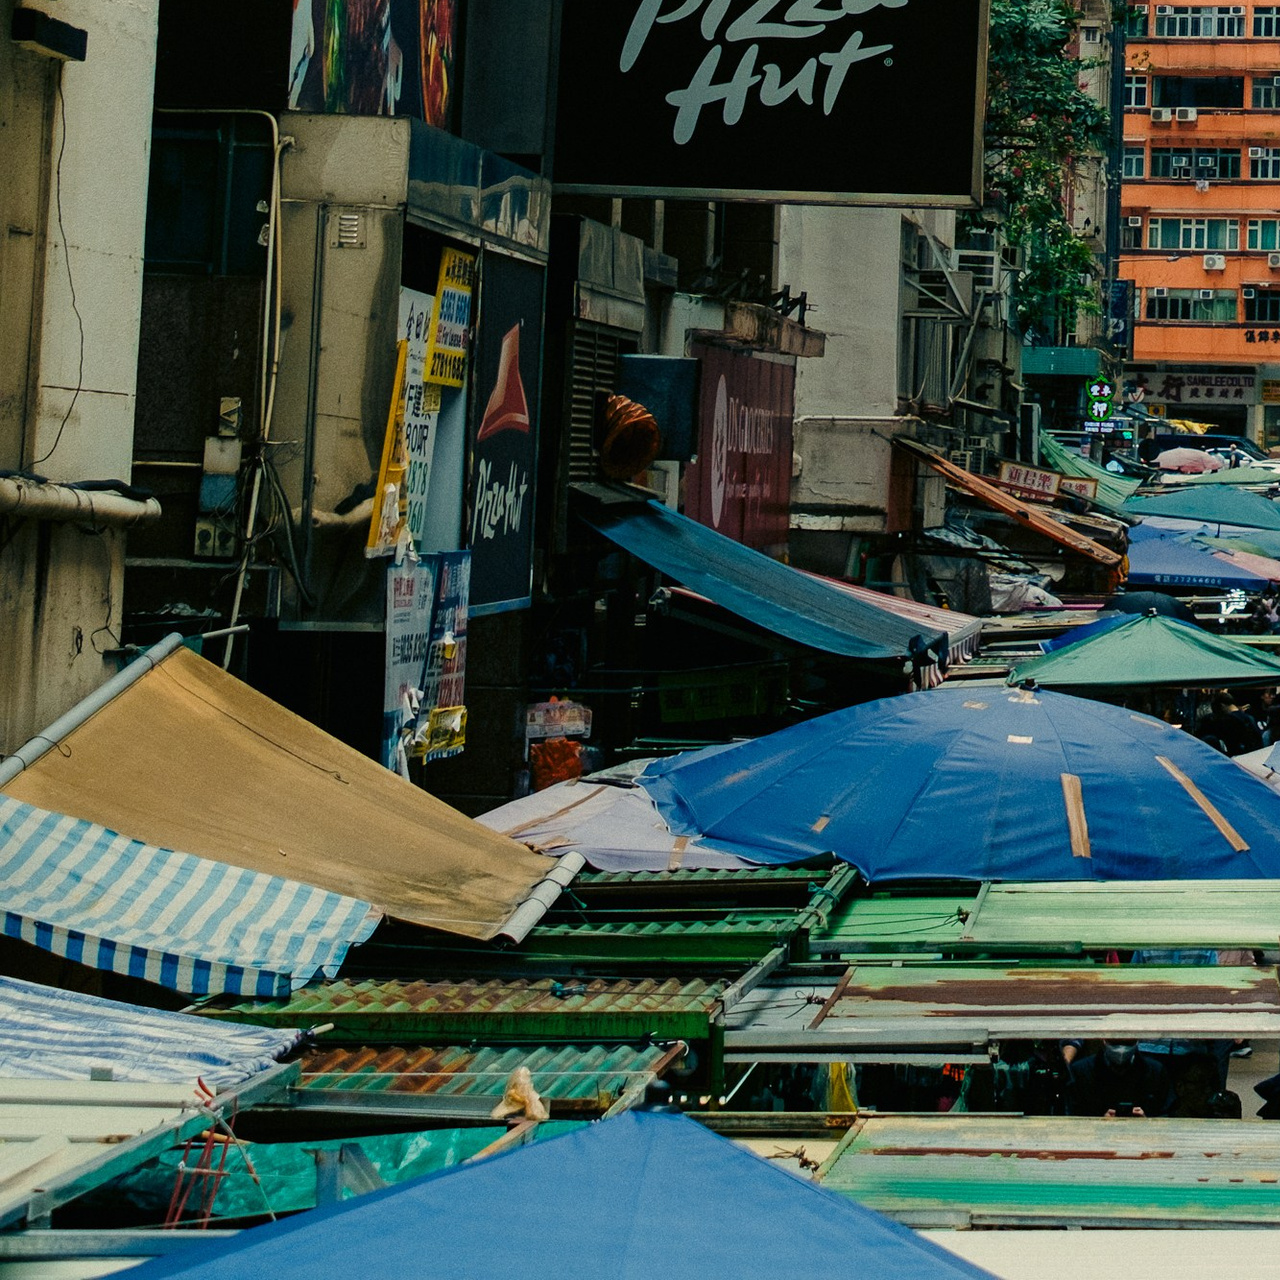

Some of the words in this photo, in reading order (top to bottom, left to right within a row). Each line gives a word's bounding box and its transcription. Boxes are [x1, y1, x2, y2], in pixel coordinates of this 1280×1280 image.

[665, 31, 893, 145] Hut
[472, 458, 505, 546] Pizza
[503, 460, 528, 536] Hut
